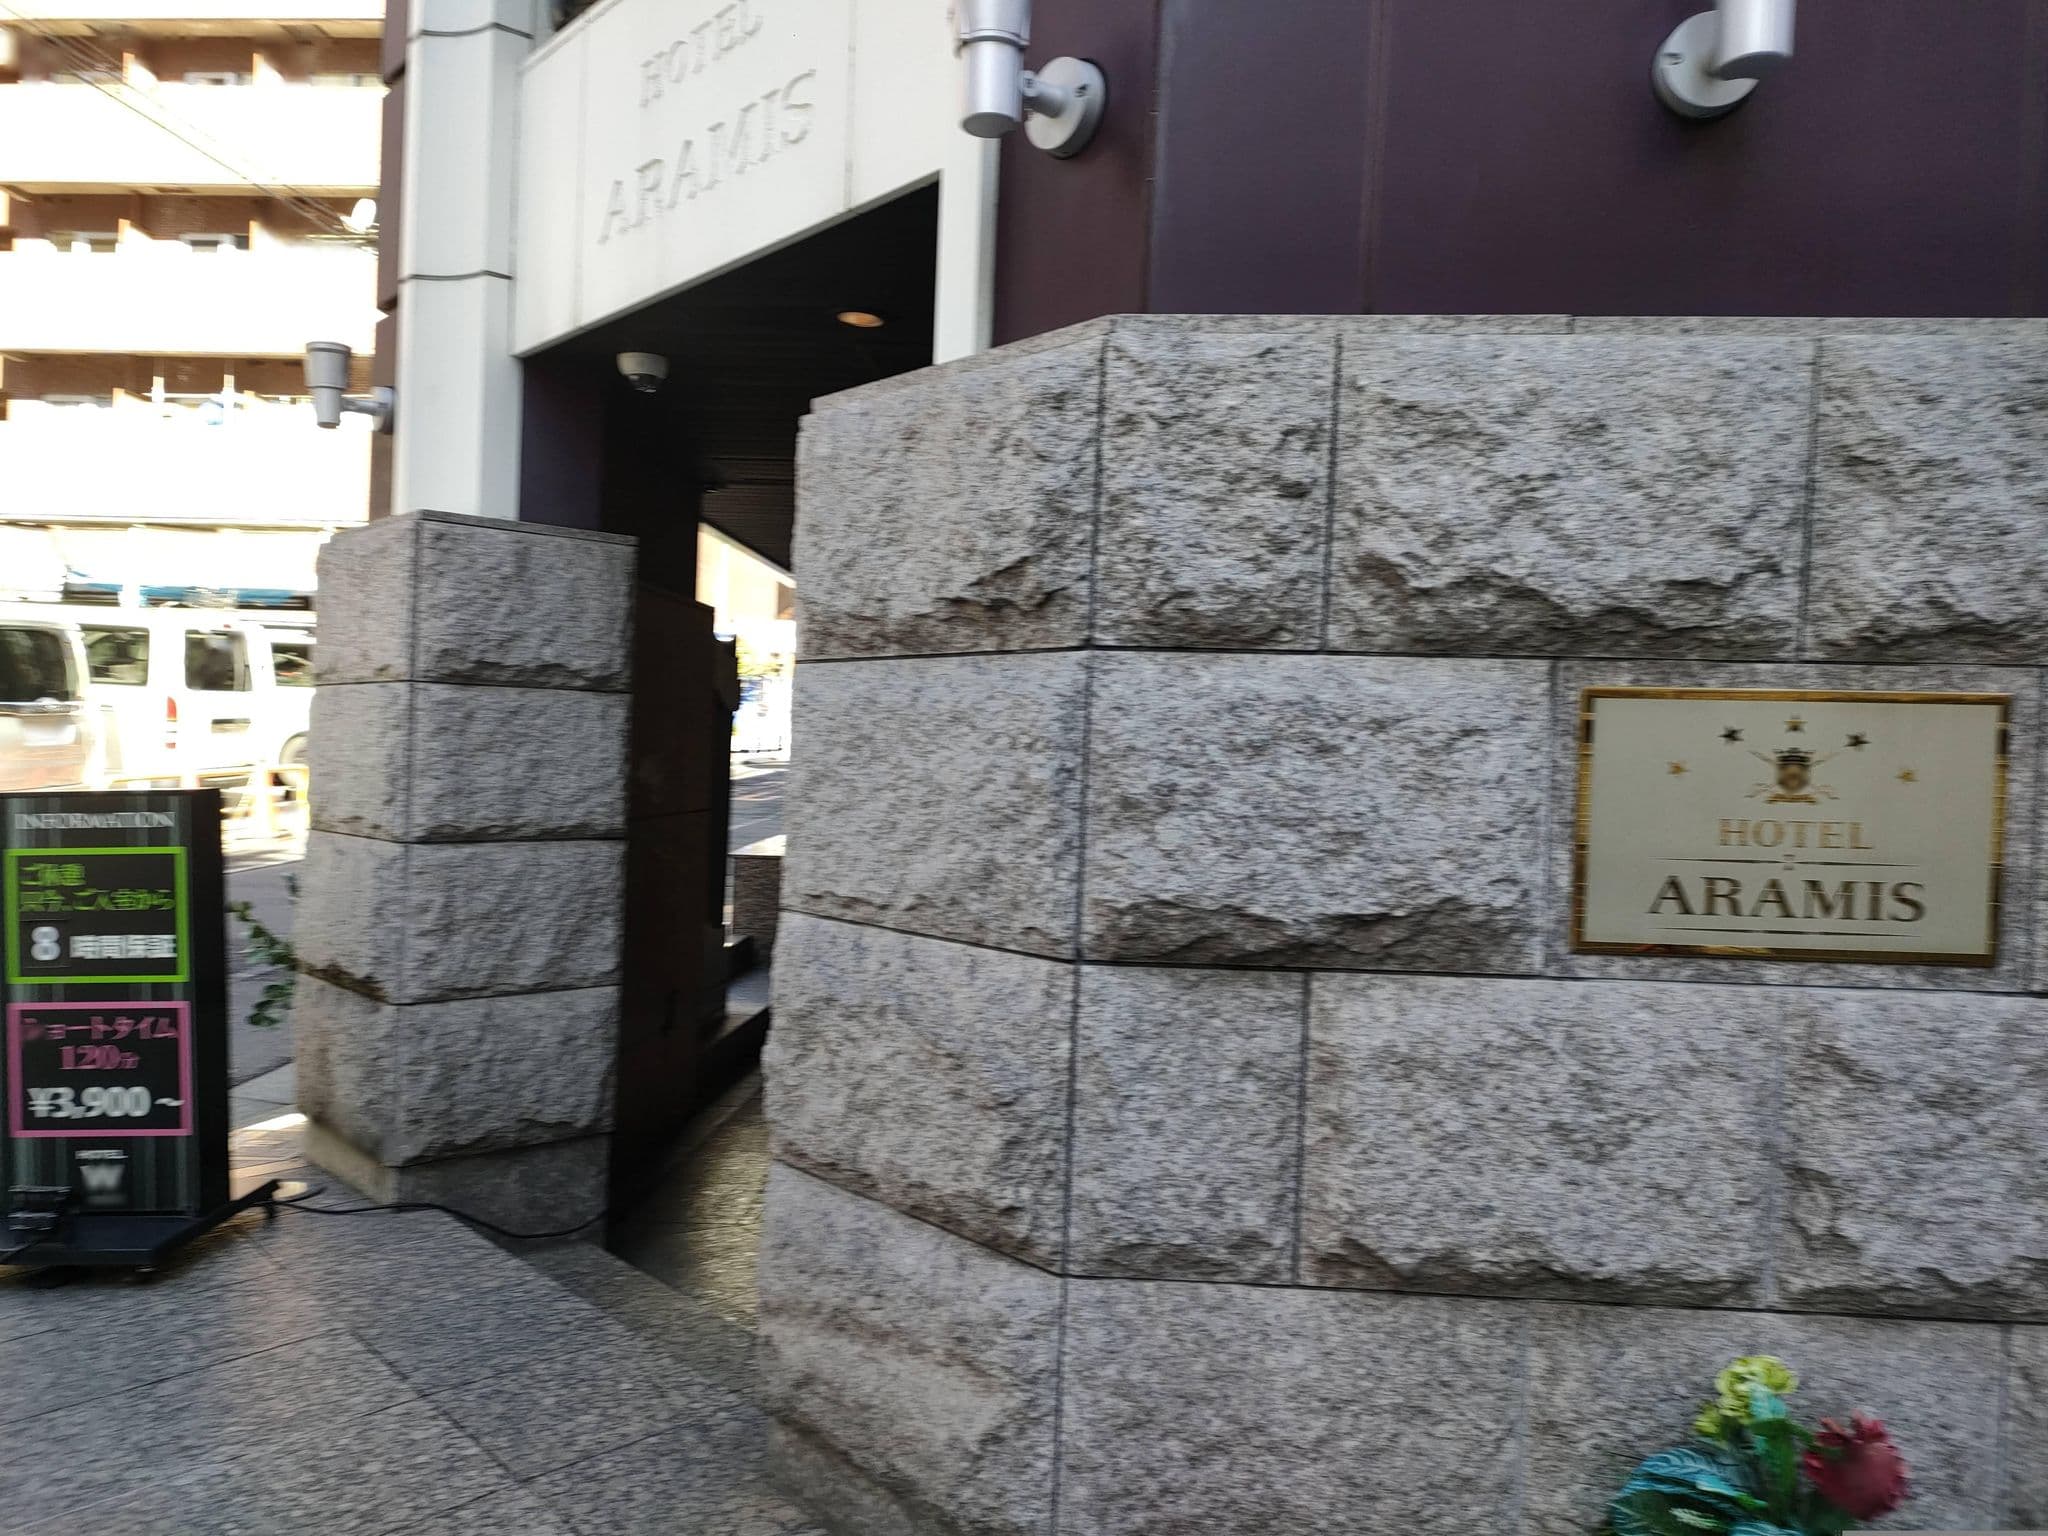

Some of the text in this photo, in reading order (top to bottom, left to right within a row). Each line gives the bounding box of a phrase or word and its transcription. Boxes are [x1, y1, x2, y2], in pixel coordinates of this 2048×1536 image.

[597, 68, 817, 244] ARAMIS
[1718, 818, 1874, 850] HOTEL
[1647, 875, 1928, 922] ARAMIS
